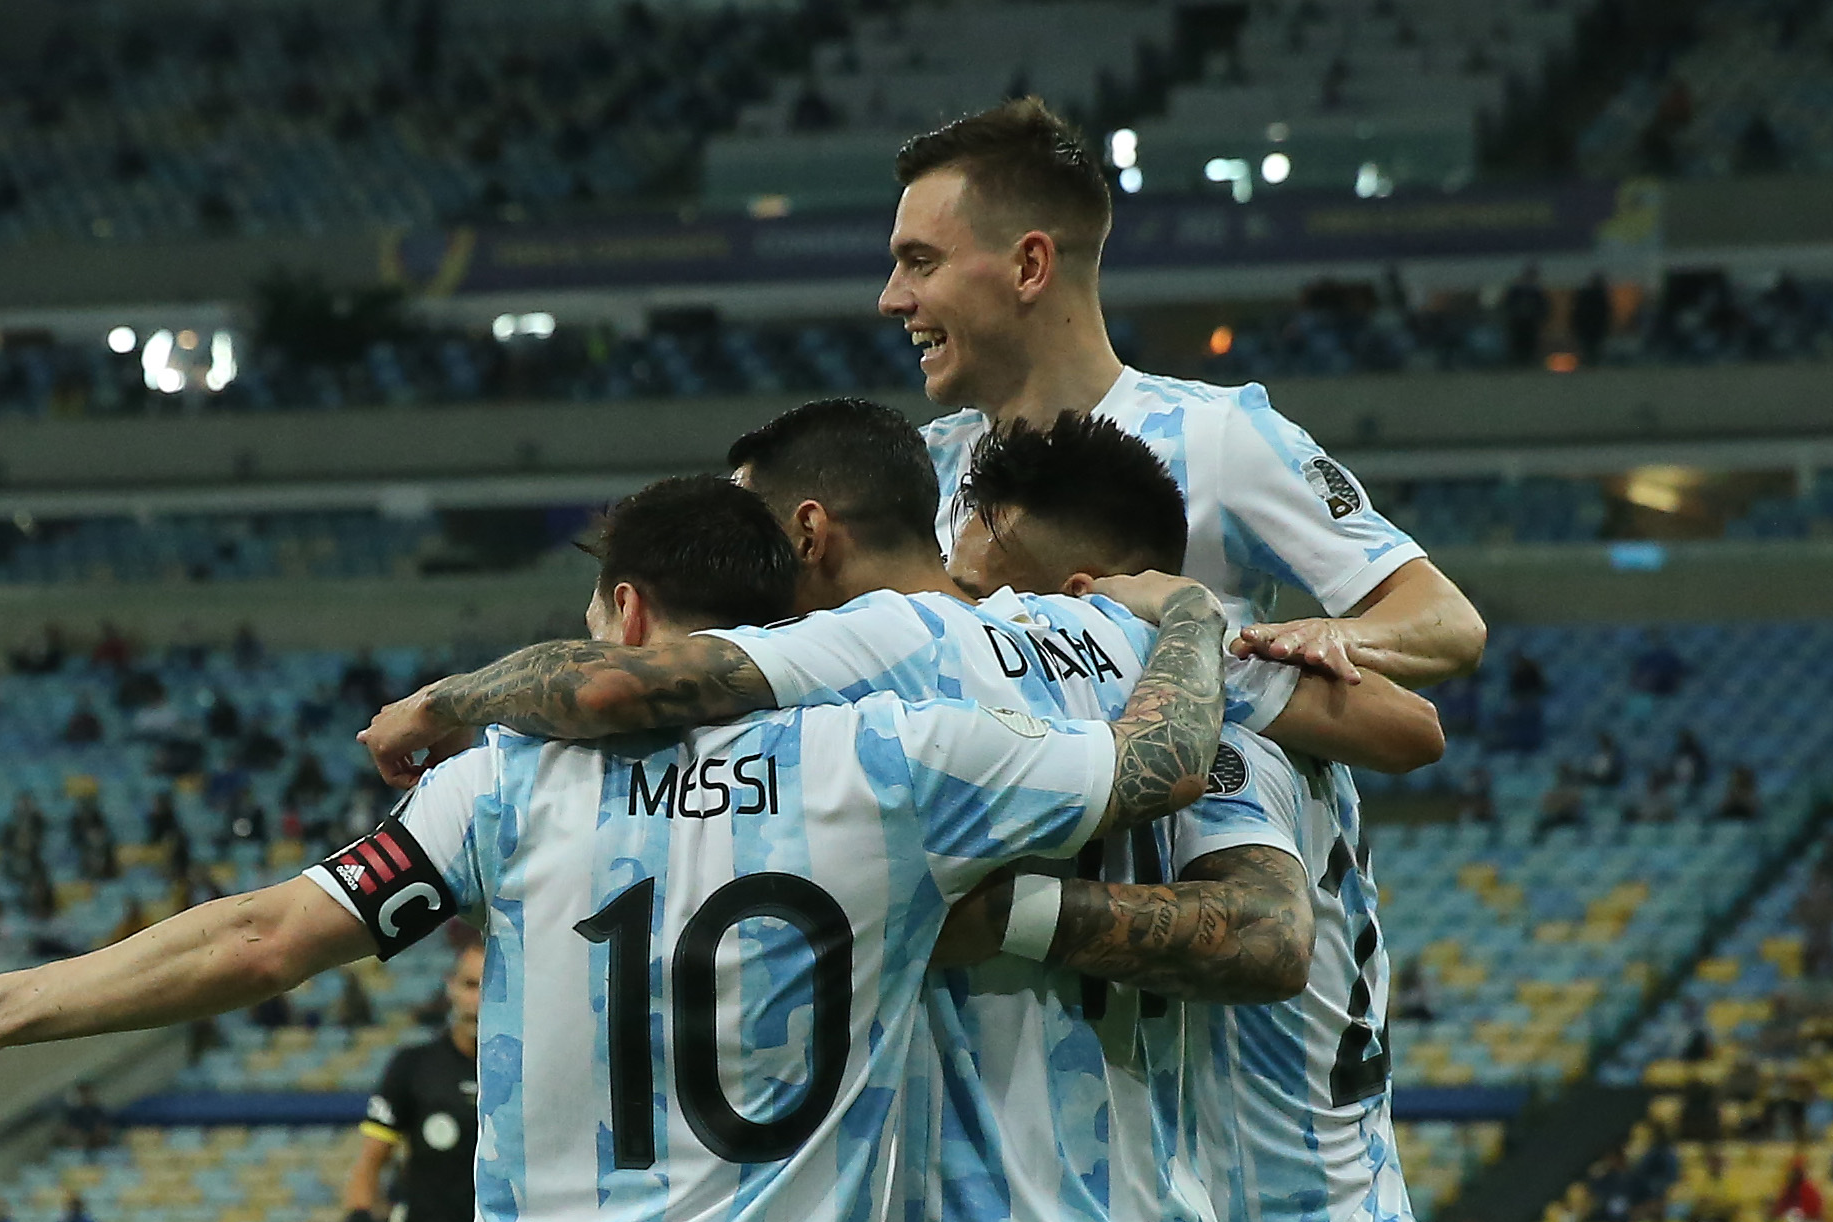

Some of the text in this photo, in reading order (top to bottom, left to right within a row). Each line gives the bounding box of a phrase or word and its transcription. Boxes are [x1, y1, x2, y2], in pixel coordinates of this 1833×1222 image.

[628, 752, 778, 819] MESSI
[378, 881, 442, 938] C
[572, 872, 854, 1170] 10
